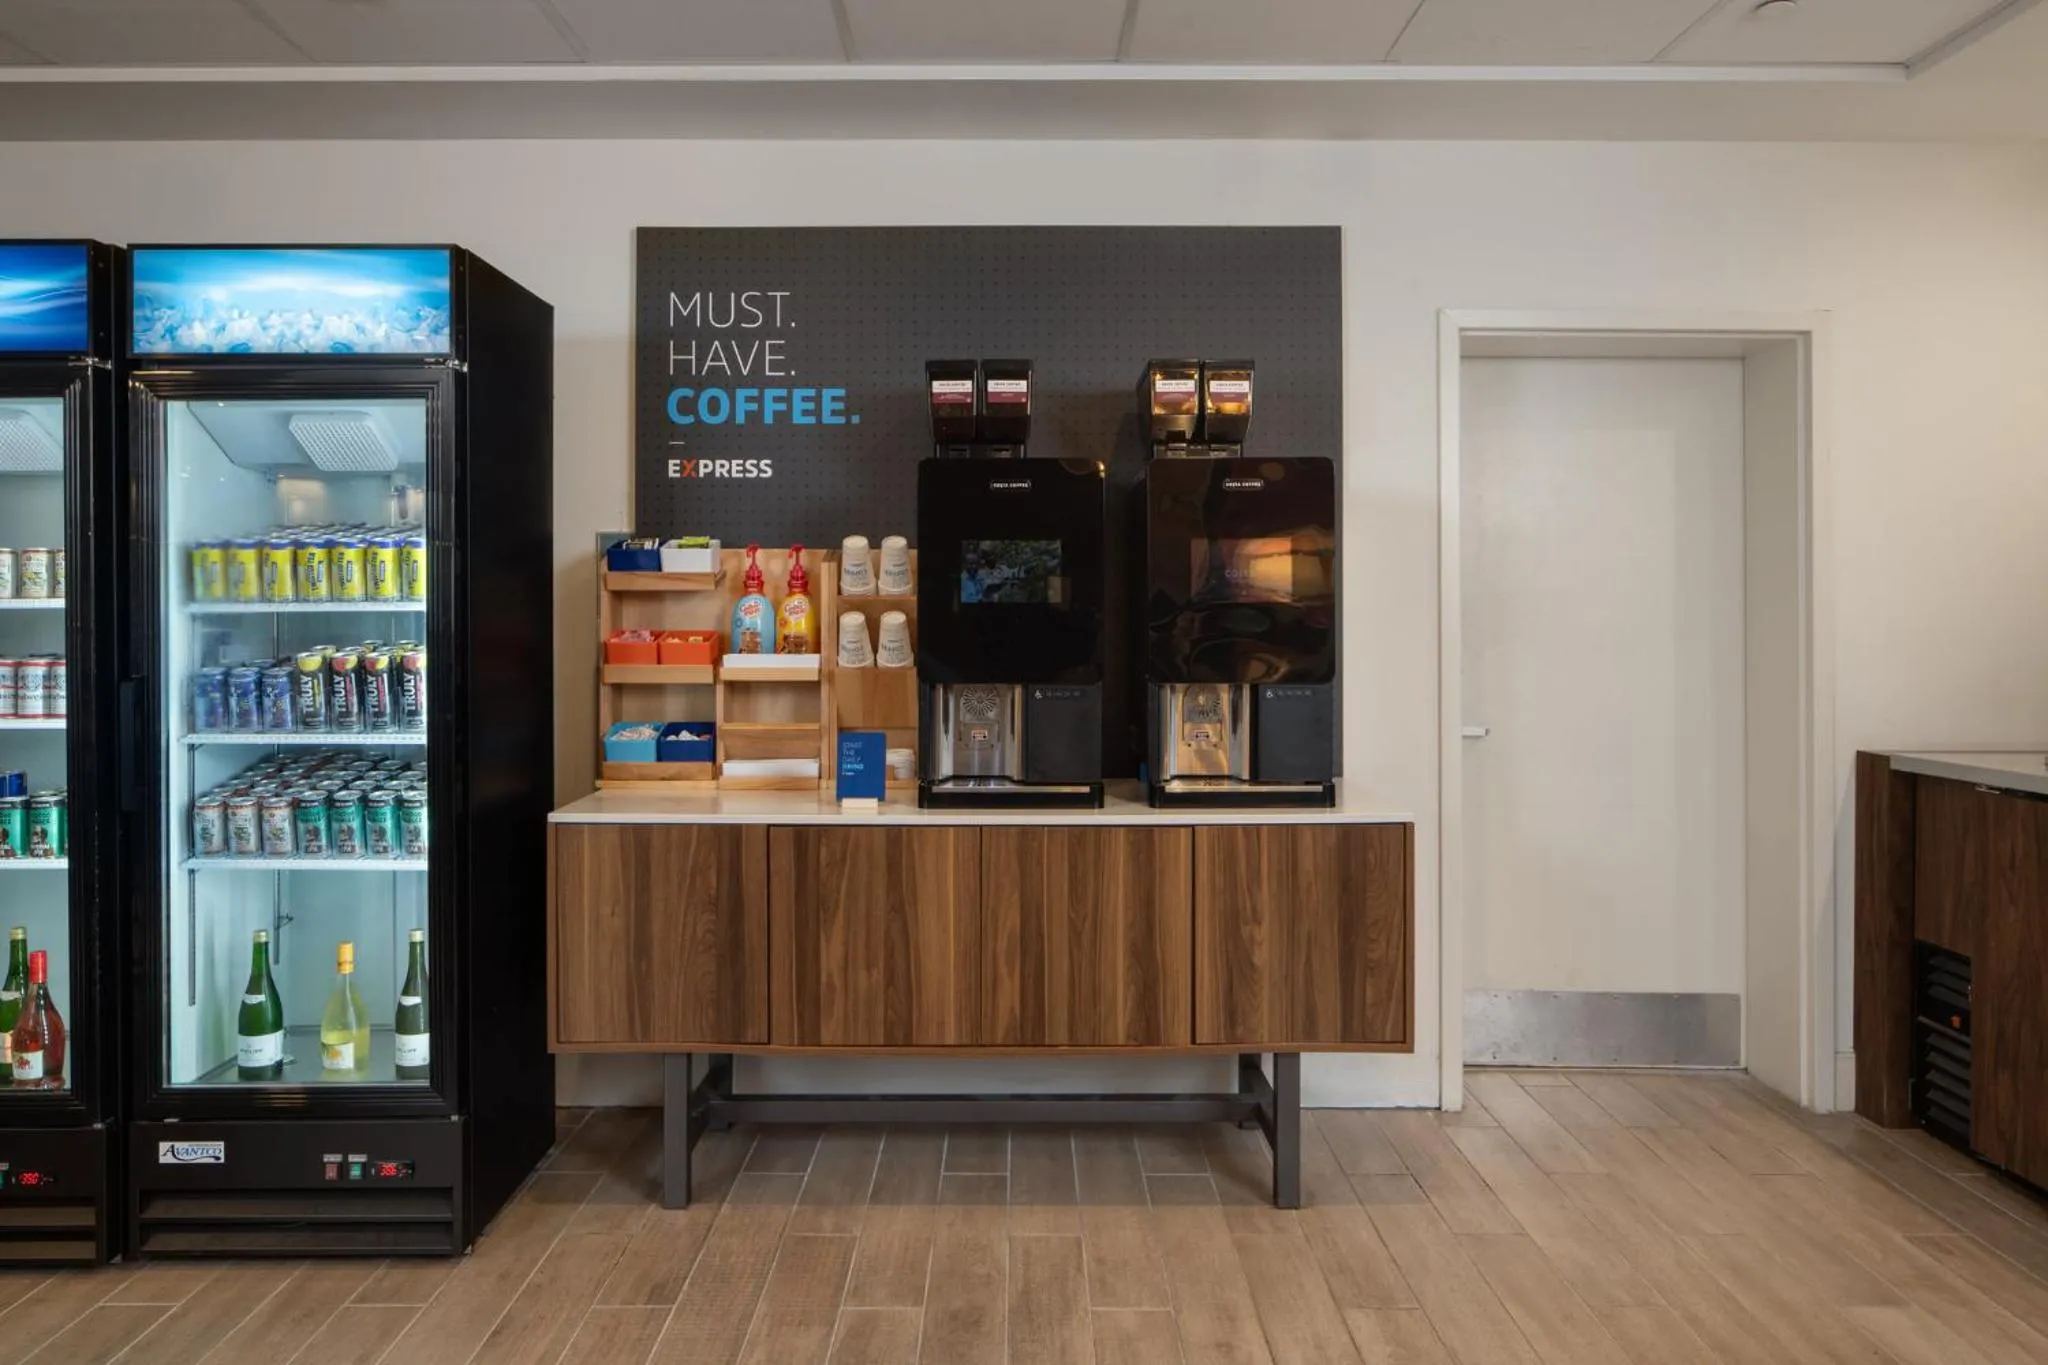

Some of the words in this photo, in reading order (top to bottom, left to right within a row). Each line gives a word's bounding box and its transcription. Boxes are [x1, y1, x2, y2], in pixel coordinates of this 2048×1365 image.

[669, 291, 797, 328] MUST.
[669, 339, 797, 377] HAVE.
[666, 387, 861, 425] COFFEE.
[667, 459, 774, 479] EXPRESS
[300, 674, 314, 714] TRULY
[332, 673, 347, 713] TRULY
[366, 674, 379, 713] TRULY
[403, 672, 416, 712] TRULY
